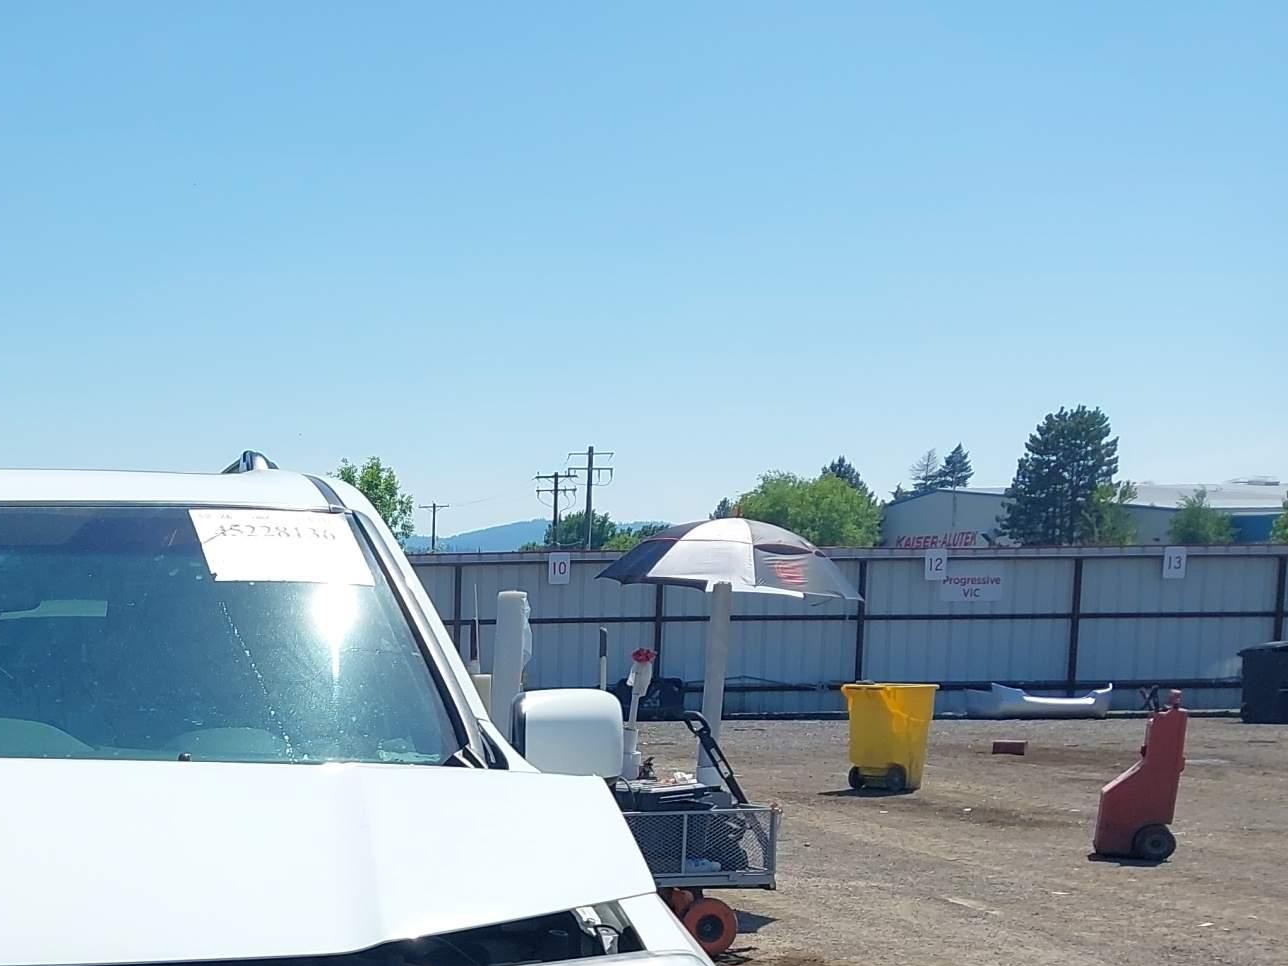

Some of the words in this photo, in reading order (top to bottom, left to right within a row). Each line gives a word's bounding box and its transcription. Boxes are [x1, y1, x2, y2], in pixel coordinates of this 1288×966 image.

[552, 561, 567, 575] 10
[929, 557, 943, 572] 12
[1167, 555, 1182, 570] 13
[943, 575, 1001, 587] Progressive
[962, 588, 981, 598] VIC
